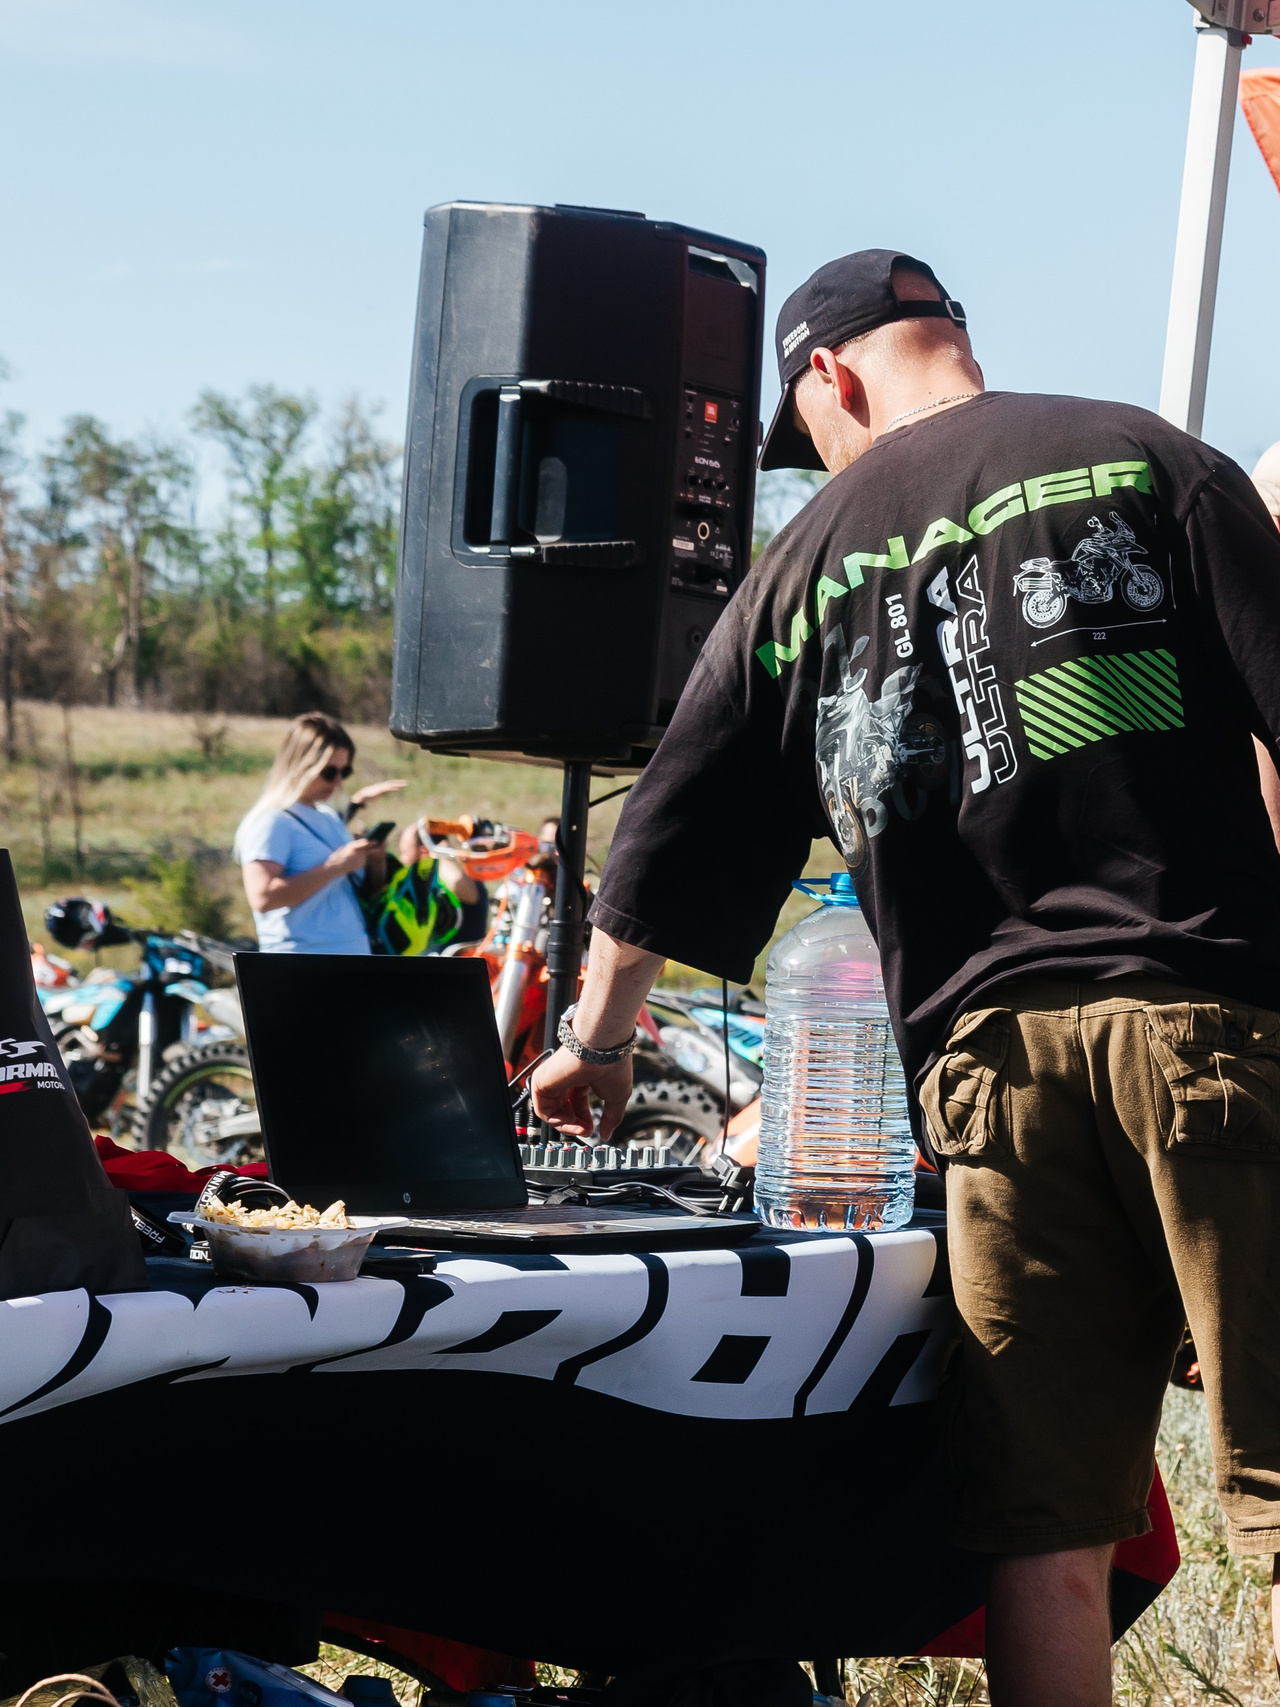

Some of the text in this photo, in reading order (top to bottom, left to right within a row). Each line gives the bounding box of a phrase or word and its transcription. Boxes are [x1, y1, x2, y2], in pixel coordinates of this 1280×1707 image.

[755, 461, 1155, 679] MANAGER
[884, 593, 914, 659] GL 801
[926, 566, 991, 794] ULTRA
[955, 554, 1018, 784] ULTRA
